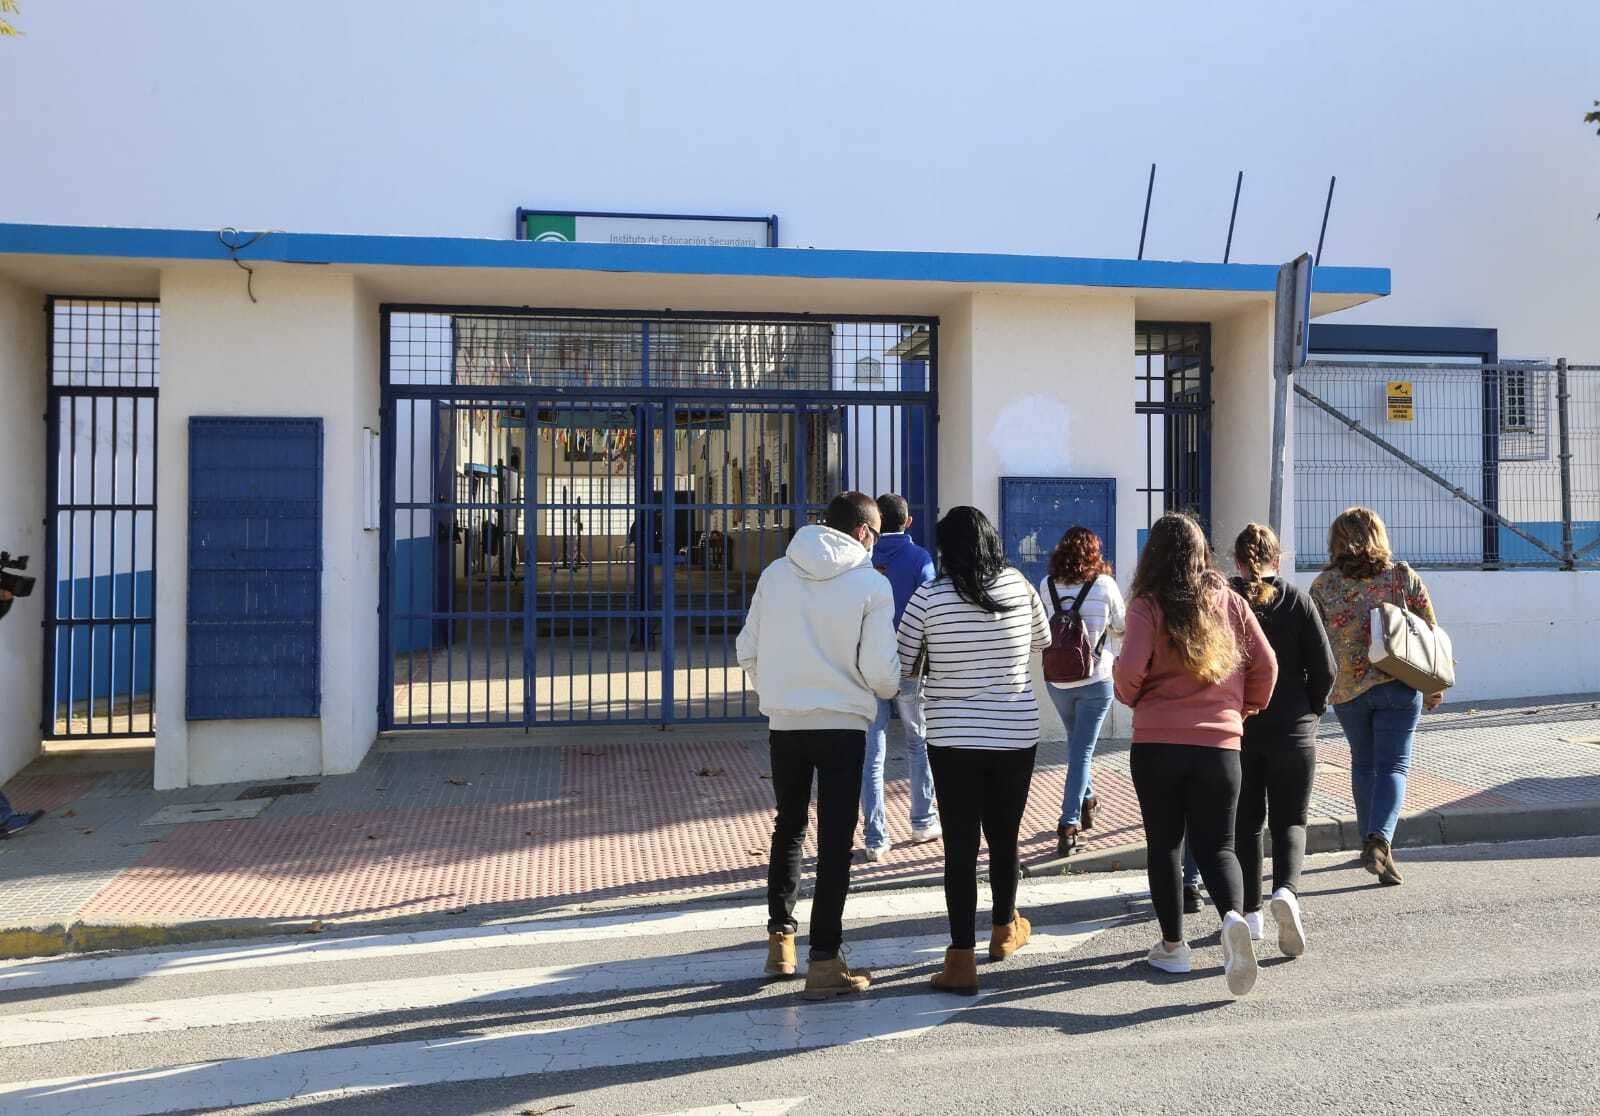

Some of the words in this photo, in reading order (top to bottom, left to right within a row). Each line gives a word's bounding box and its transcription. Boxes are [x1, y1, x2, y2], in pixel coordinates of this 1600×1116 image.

[609, 233, 647, 244] Instituto
[649, 233, 659, 244] de
[662, 235, 706, 245] Educación
[709, 236, 756, 247] Secundaria
